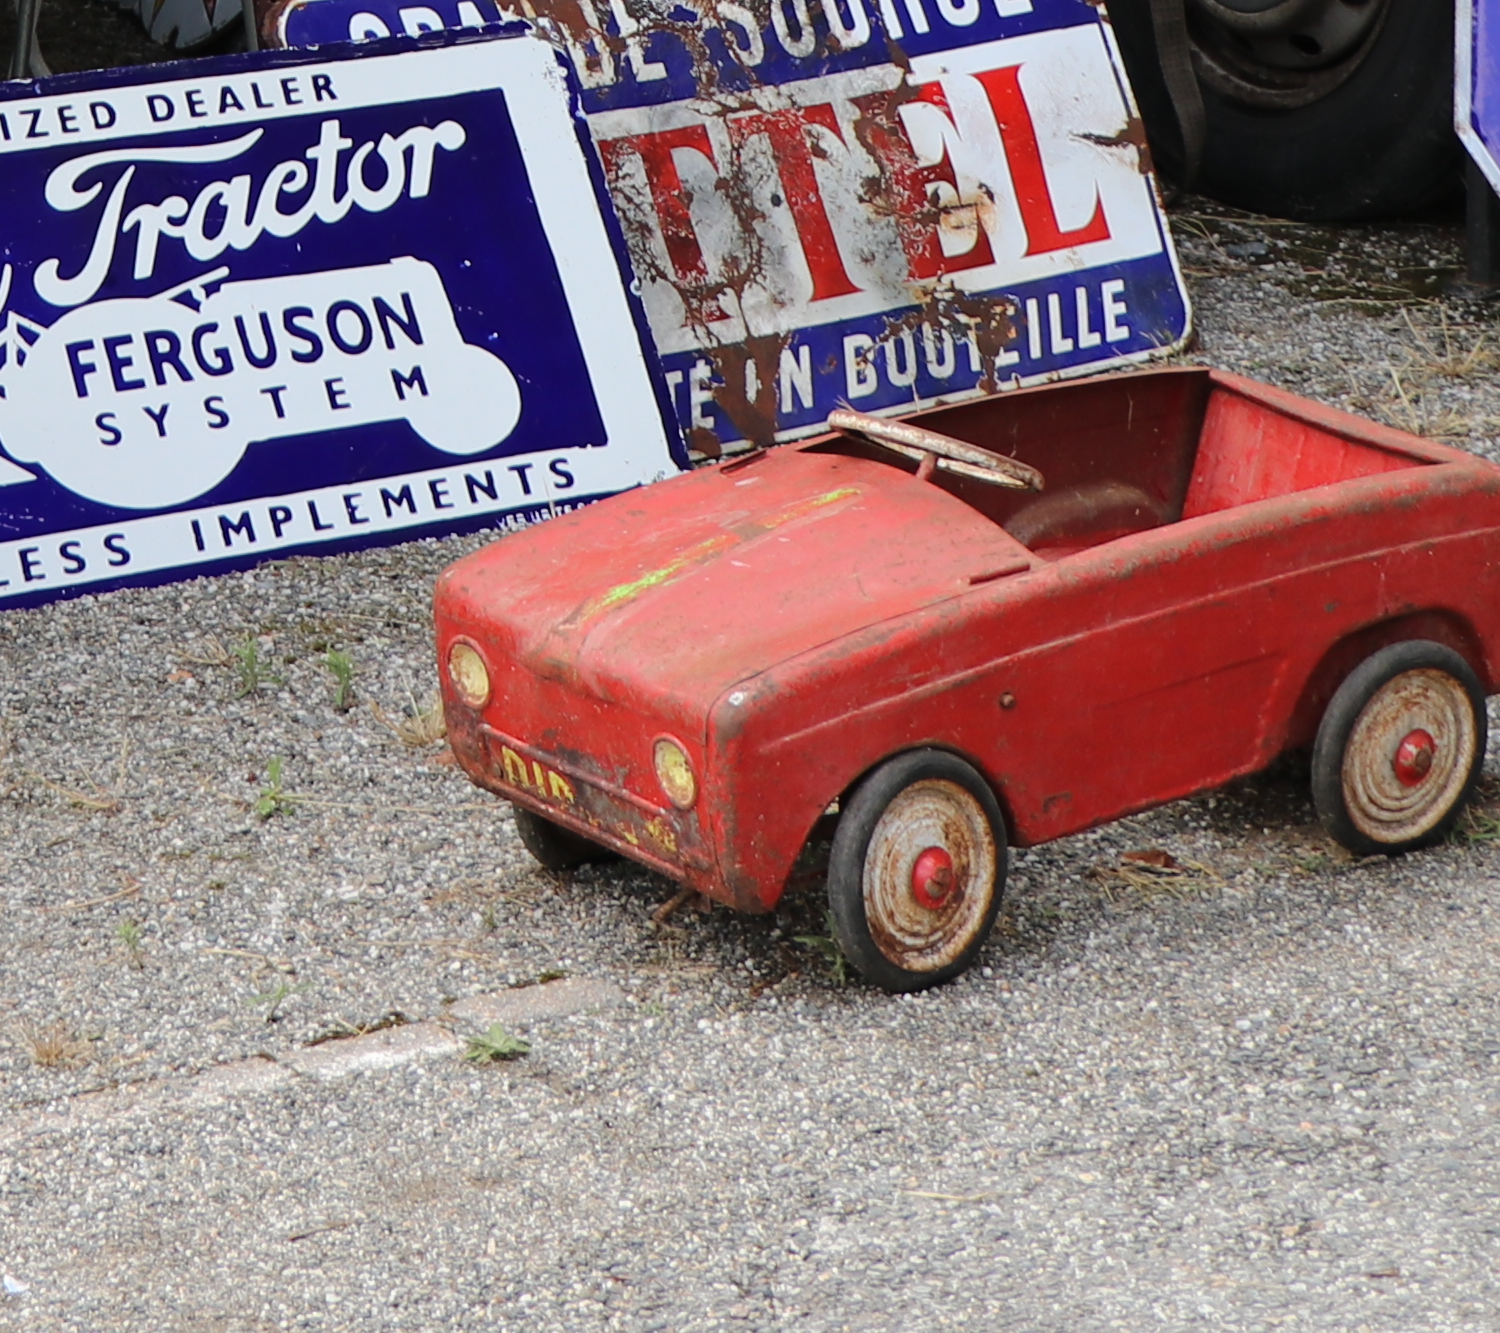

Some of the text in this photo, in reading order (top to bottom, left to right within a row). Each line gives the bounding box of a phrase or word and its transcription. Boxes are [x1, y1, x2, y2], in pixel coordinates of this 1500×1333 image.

[146, 71, 338, 126] DEALER
[34, 118, 467, 308] Tractor
[65, 291, 425, 400] FERGUSON
[96, 365, 432, 447] SYSTEM
[189, 455, 579, 553] IMPLEMENTS
